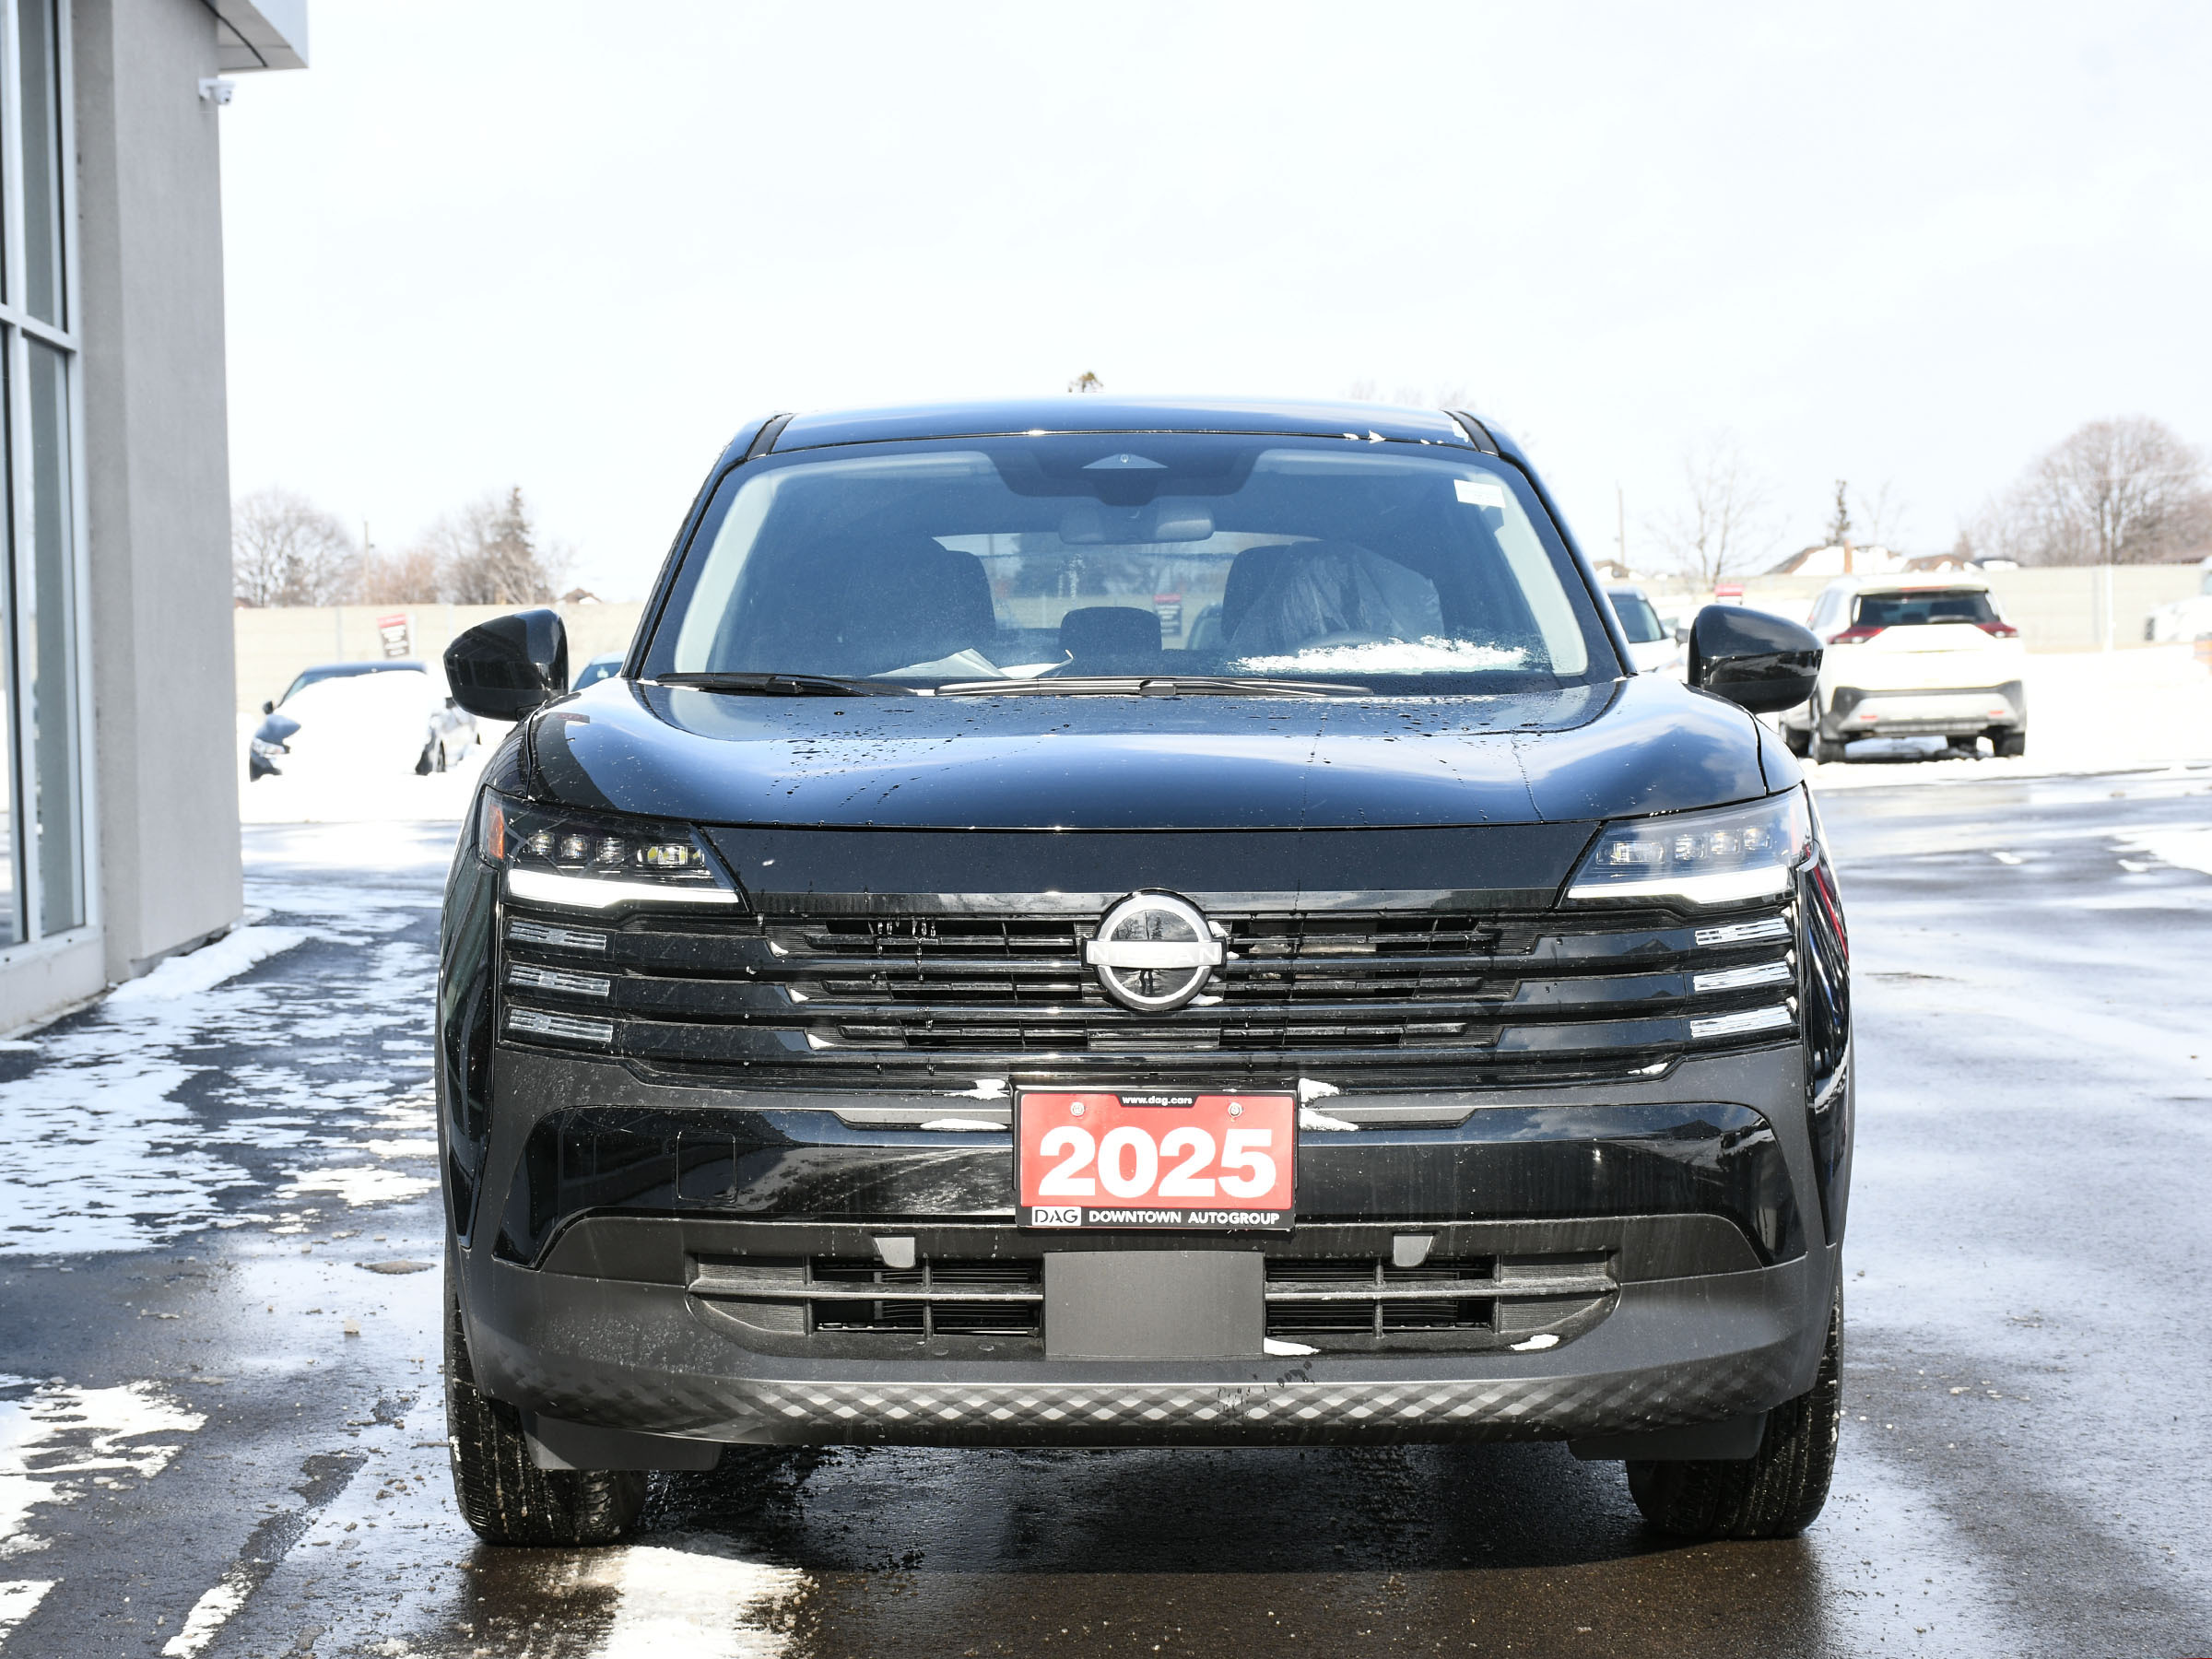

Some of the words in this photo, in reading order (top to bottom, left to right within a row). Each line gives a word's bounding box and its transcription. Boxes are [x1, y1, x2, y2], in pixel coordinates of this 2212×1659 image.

[1122, 1095, 1193, 1107] www.dag.cars
[1038, 1125, 1277, 1198] 2025
[1034, 1208, 1078, 1224] DAG
[1088, 1210, 1182, 1224] DOWNTOWN
[1187, 1211, 1280, 1226] AUTOGROUP
